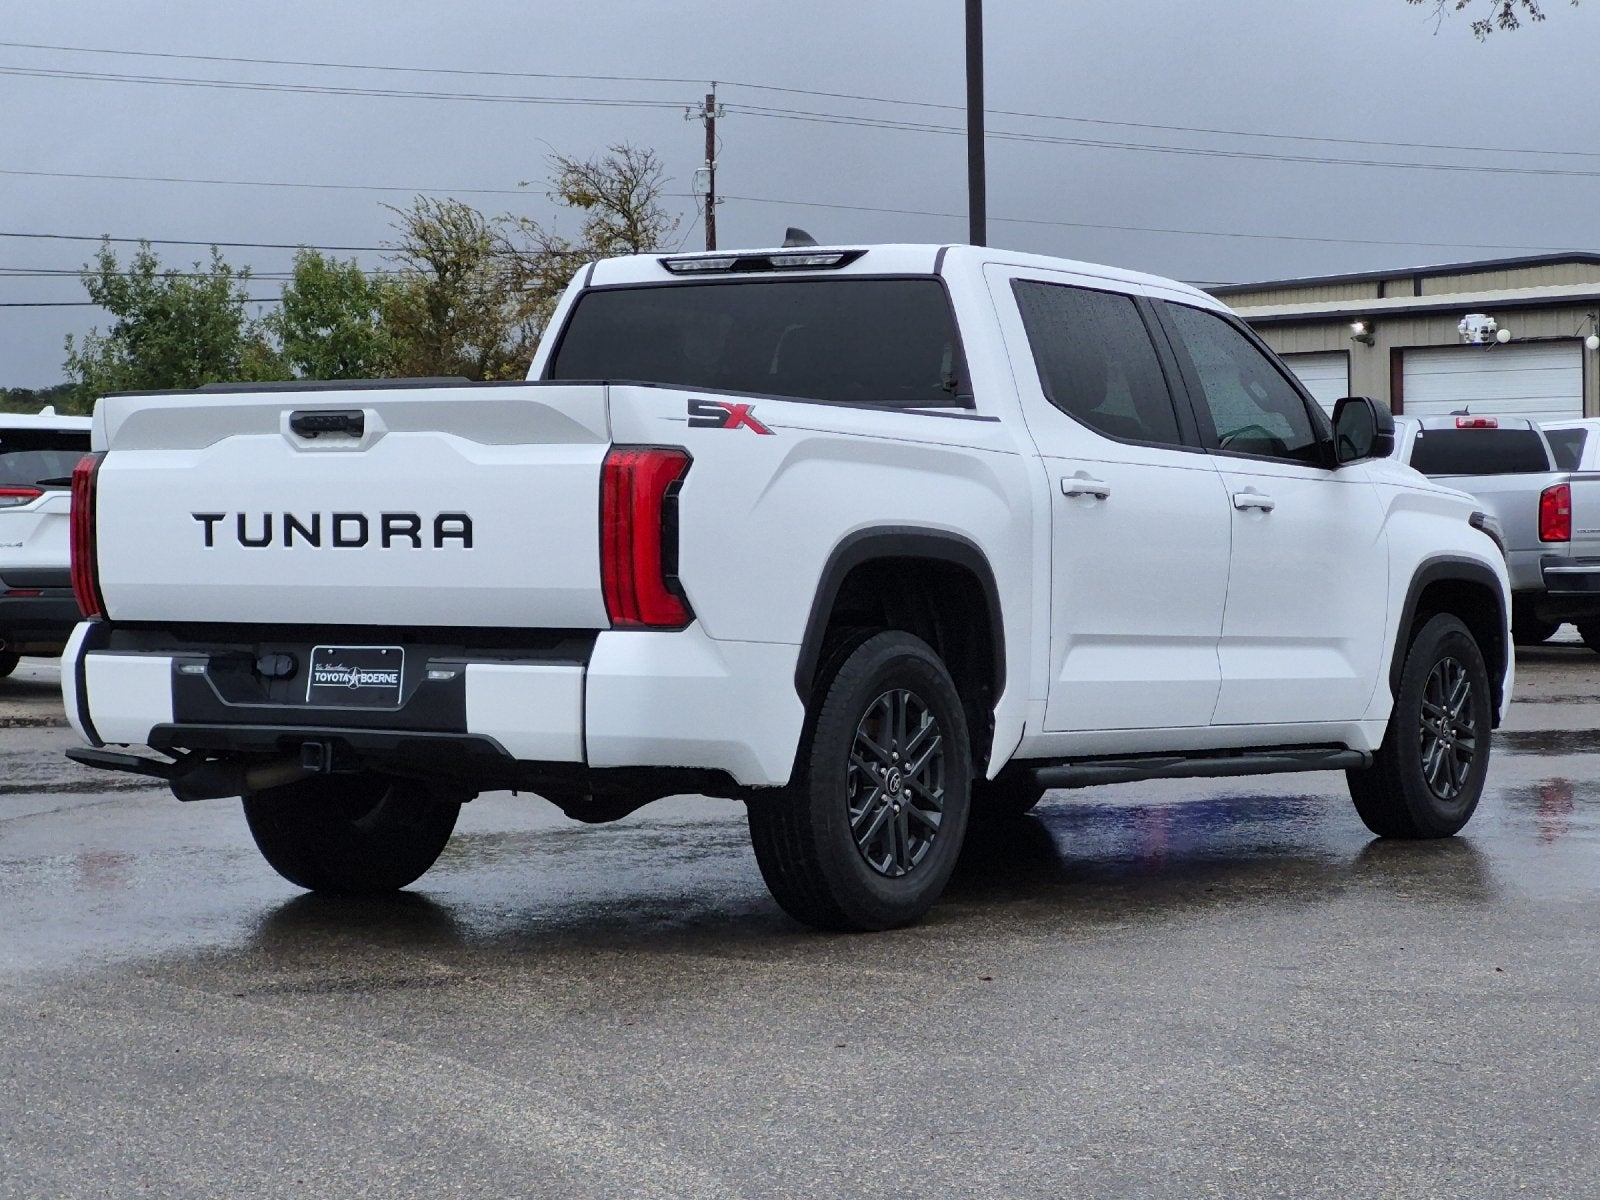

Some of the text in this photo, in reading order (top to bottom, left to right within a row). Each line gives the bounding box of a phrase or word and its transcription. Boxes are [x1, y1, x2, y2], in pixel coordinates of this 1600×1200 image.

[191, 512, 473, 548] TUNDRA
[314, 672, 398, 684] TOYOTA BOERNE
